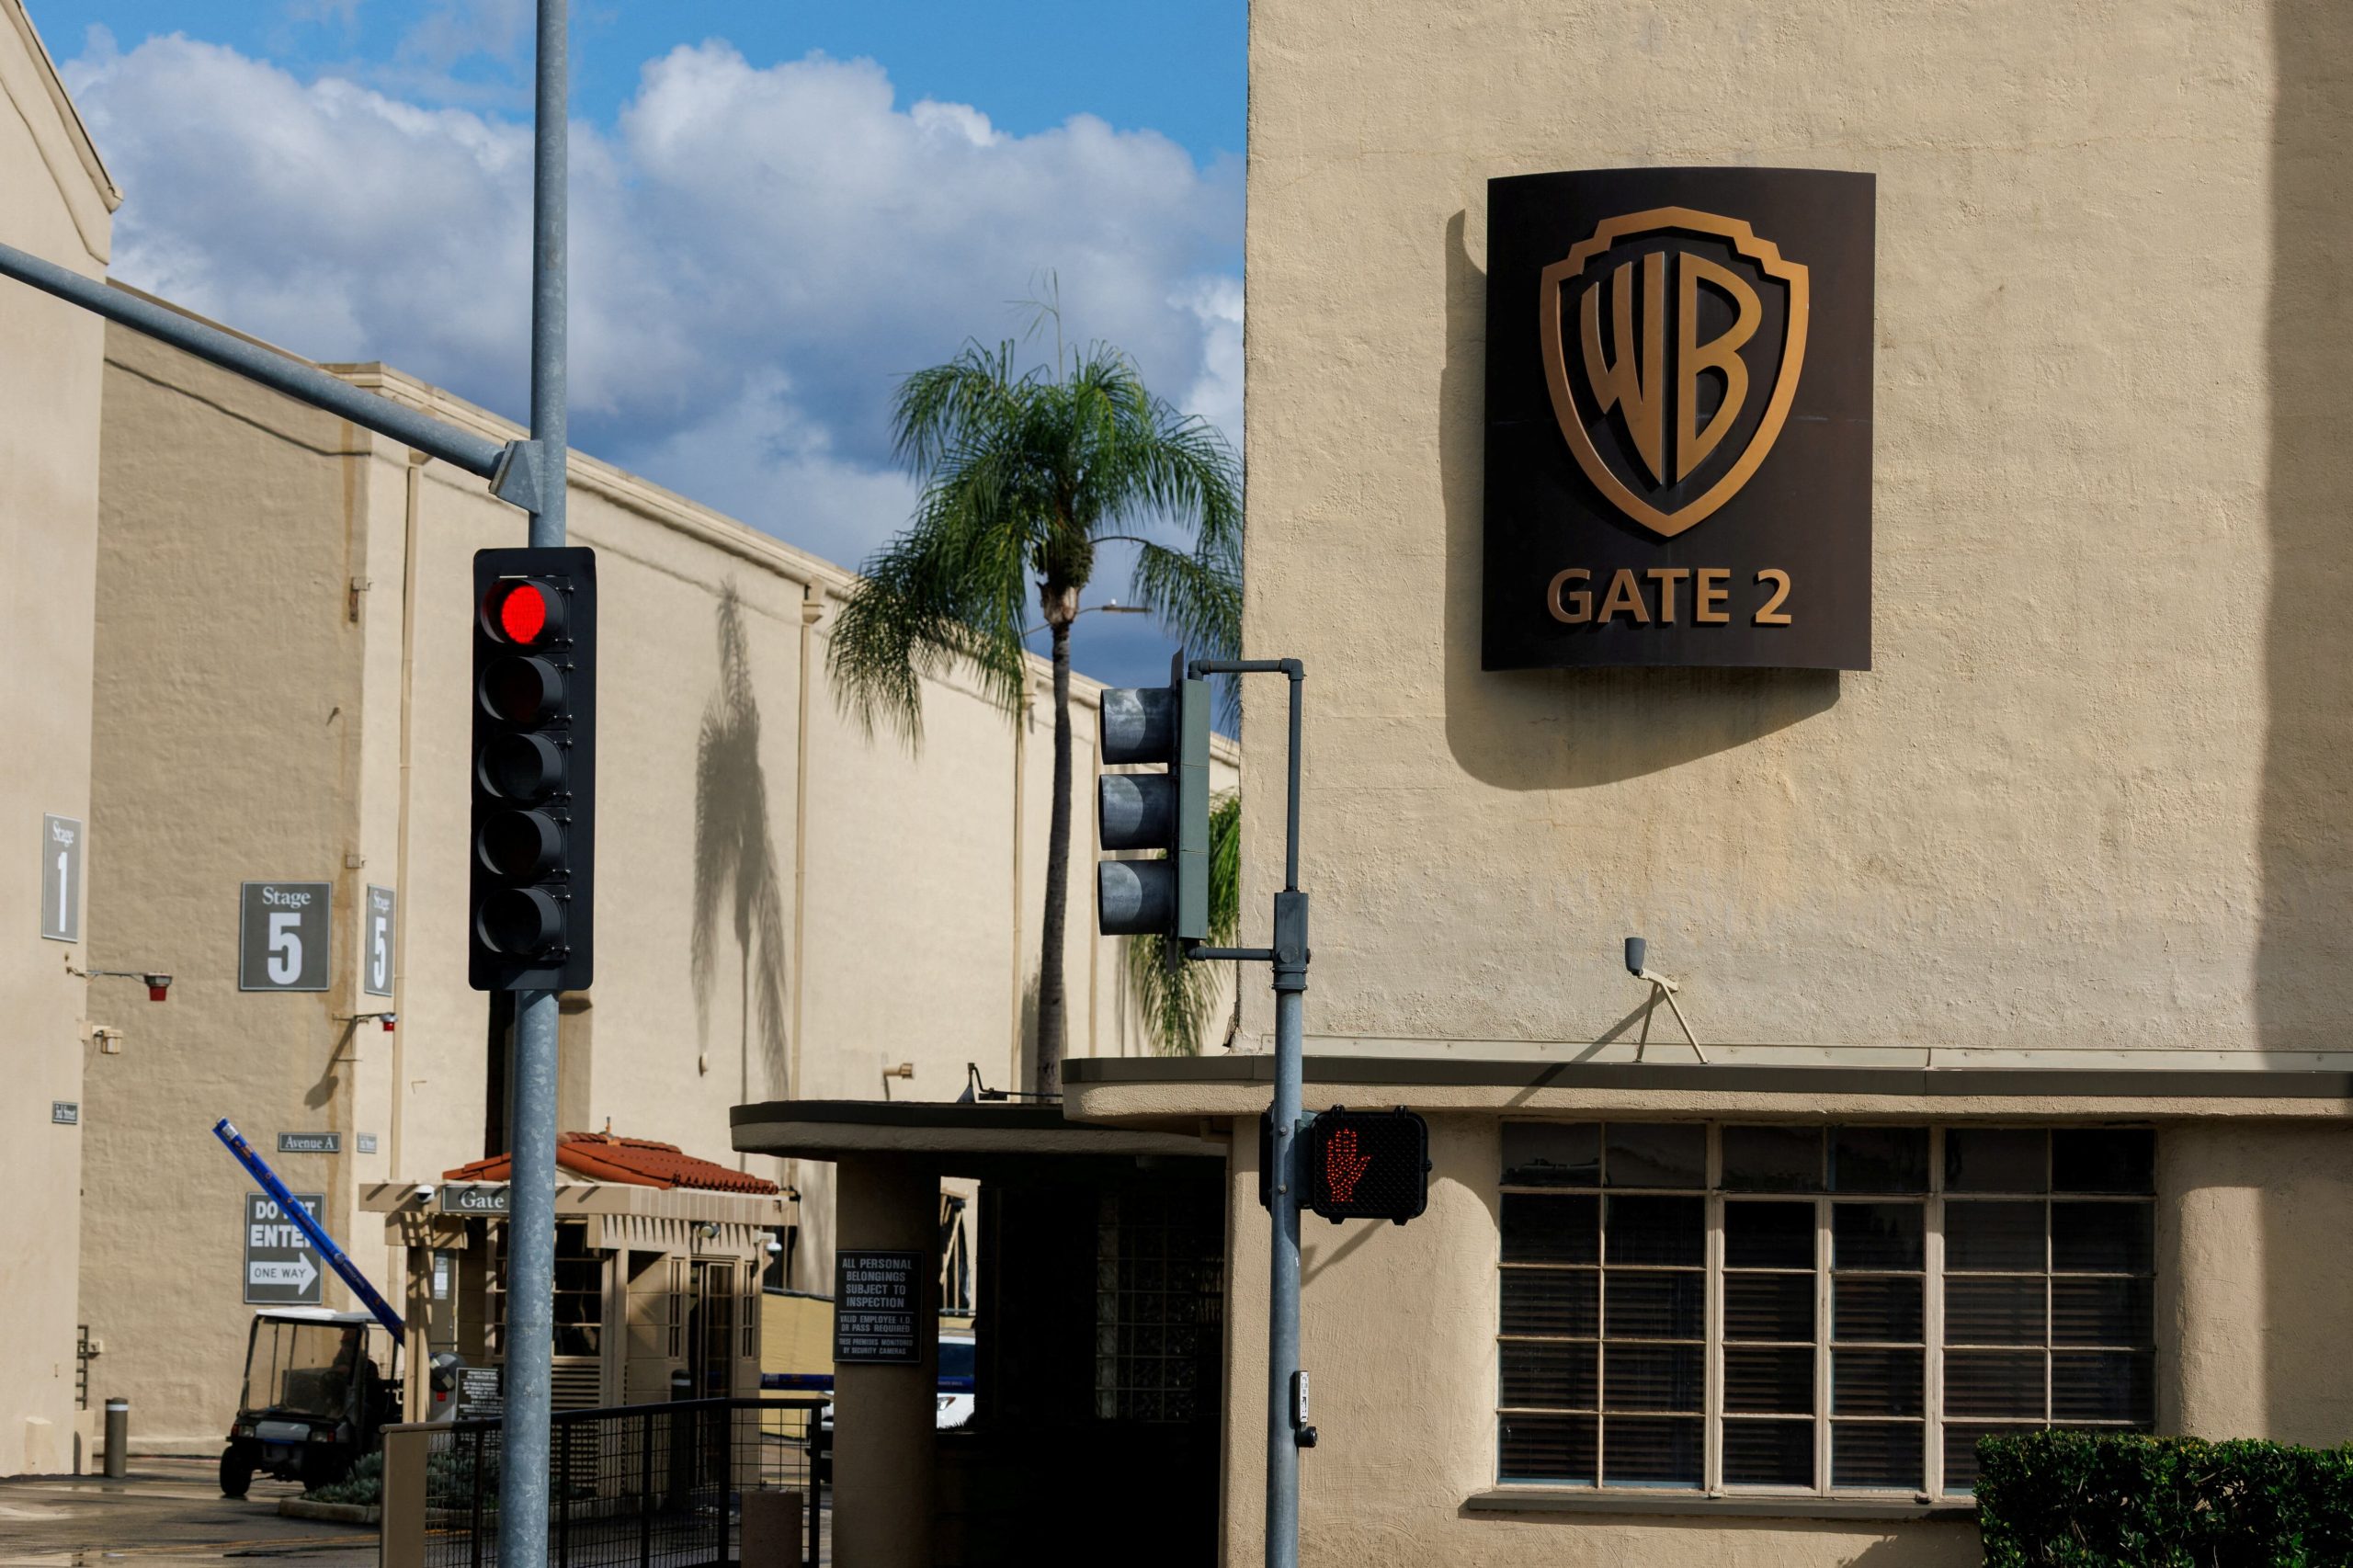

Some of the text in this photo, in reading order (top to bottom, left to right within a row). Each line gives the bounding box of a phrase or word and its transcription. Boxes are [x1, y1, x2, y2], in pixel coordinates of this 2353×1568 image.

[1579, 250, 1762, 485] WB
[1547, 568, 1792, 624] GATE 2
[52, 820, 74, 847] Stage
[58, 851, 68, 933] 1
[262, 886, 312, 909] Stage
[373, 891, 390, 915] Stage
[267, 912, 302, 985] 5
[373, 916, 386, 989] 5
[285, 1135, 334, 1149] Avenue A
[460, 1191, 505, 1208] Gate
[256, 1200, 278, 1220] DO
[254, 1268, 306, 1278] ONE WAY
[842, 1258, 912, 1269] ALL PERSONAL
[847, 1271, 905, 1281] BELONGINGS
[846, 1284, 906, 1295] SUBJECT TO
[847, 1297, 904, 1308] INSPECTION
[860, 1315, 897, 1324] EMPLOYEE
